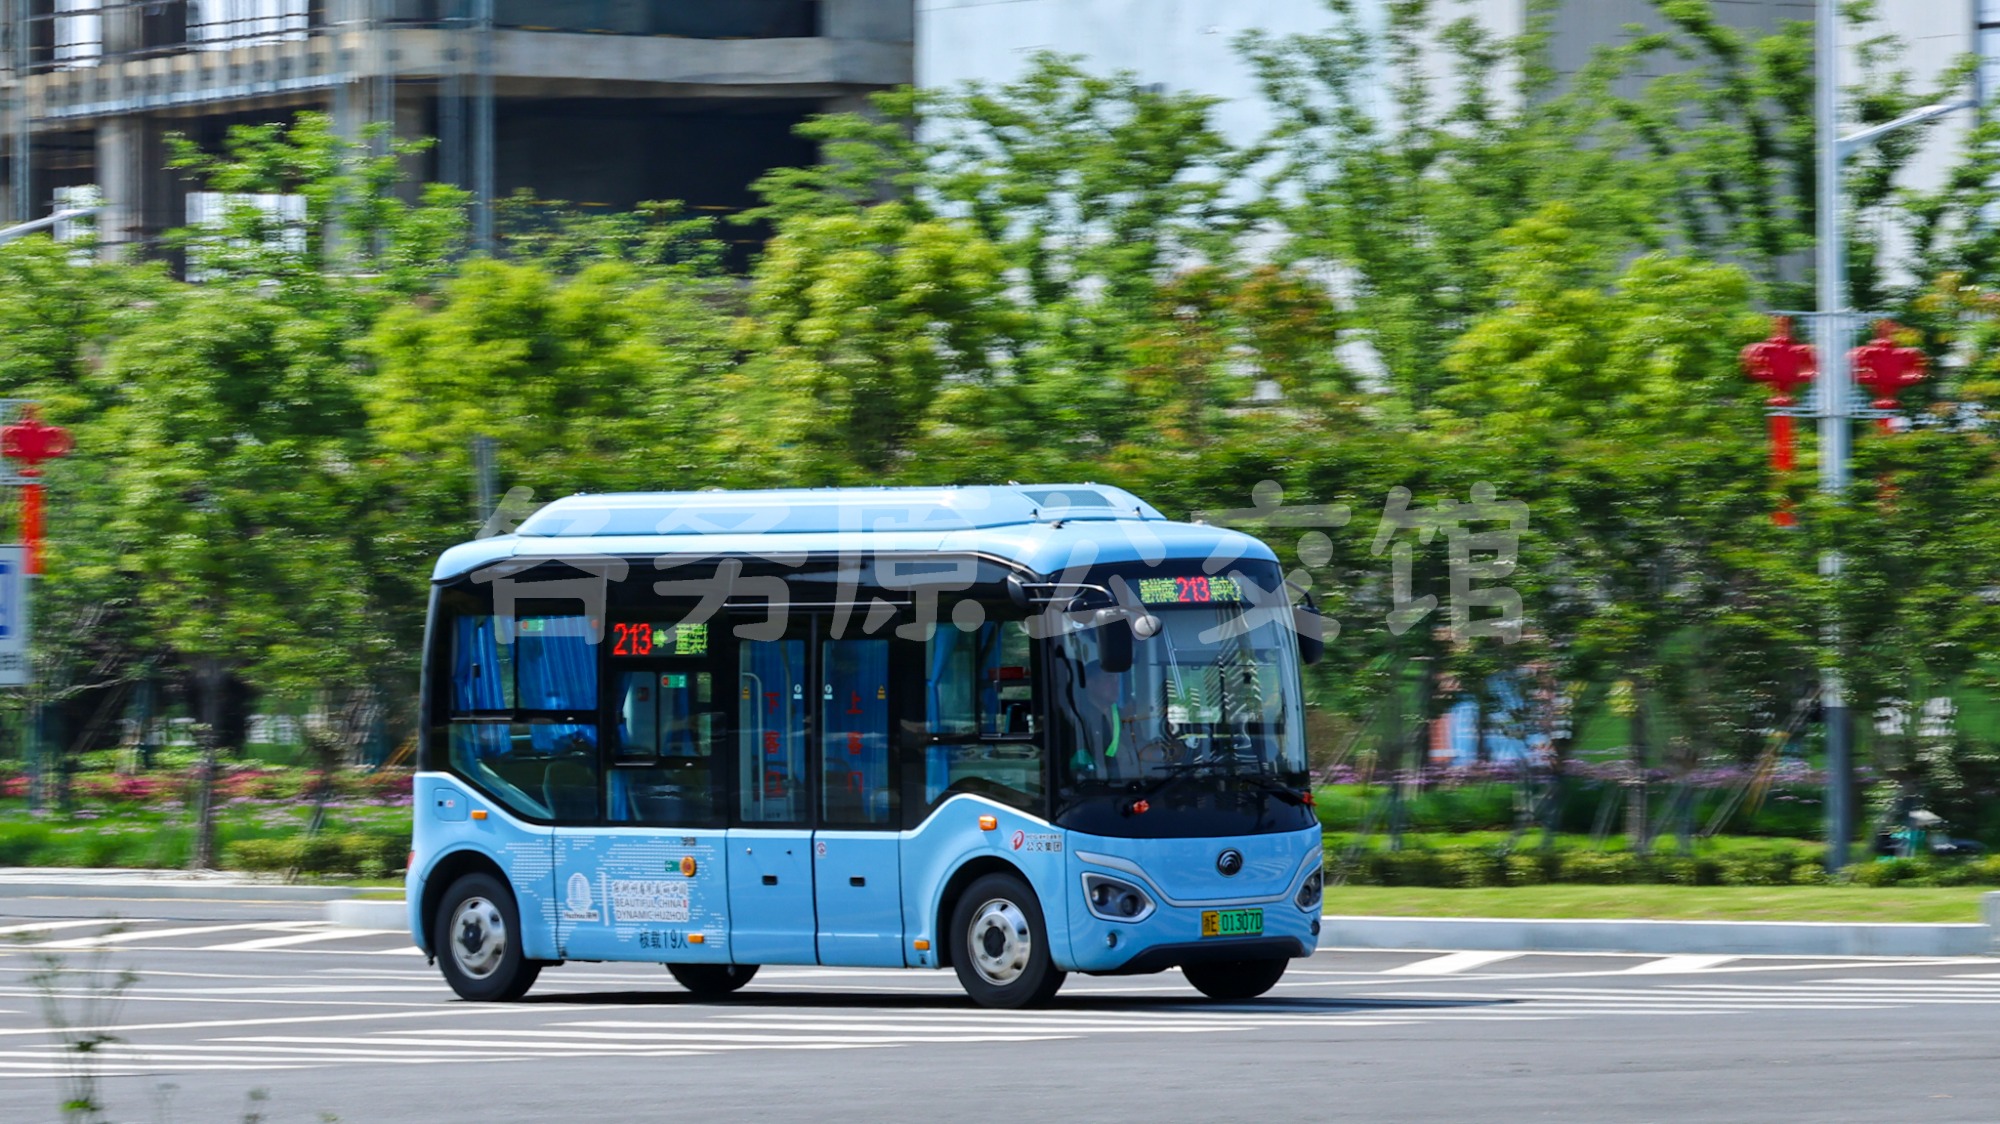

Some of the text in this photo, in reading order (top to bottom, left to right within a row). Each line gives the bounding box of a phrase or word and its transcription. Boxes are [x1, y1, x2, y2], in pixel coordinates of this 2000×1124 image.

[1176, 576, 1211, 602] 213
[613, 623, 653, 655] 213
[846, 690, 864, 794] 上客门
[1027, 841, 1062, 852] 公交集团
[615, 898, 682, 908] BEAUTIFUL CHINA
[639, 929, 688, 949] 核载19人
